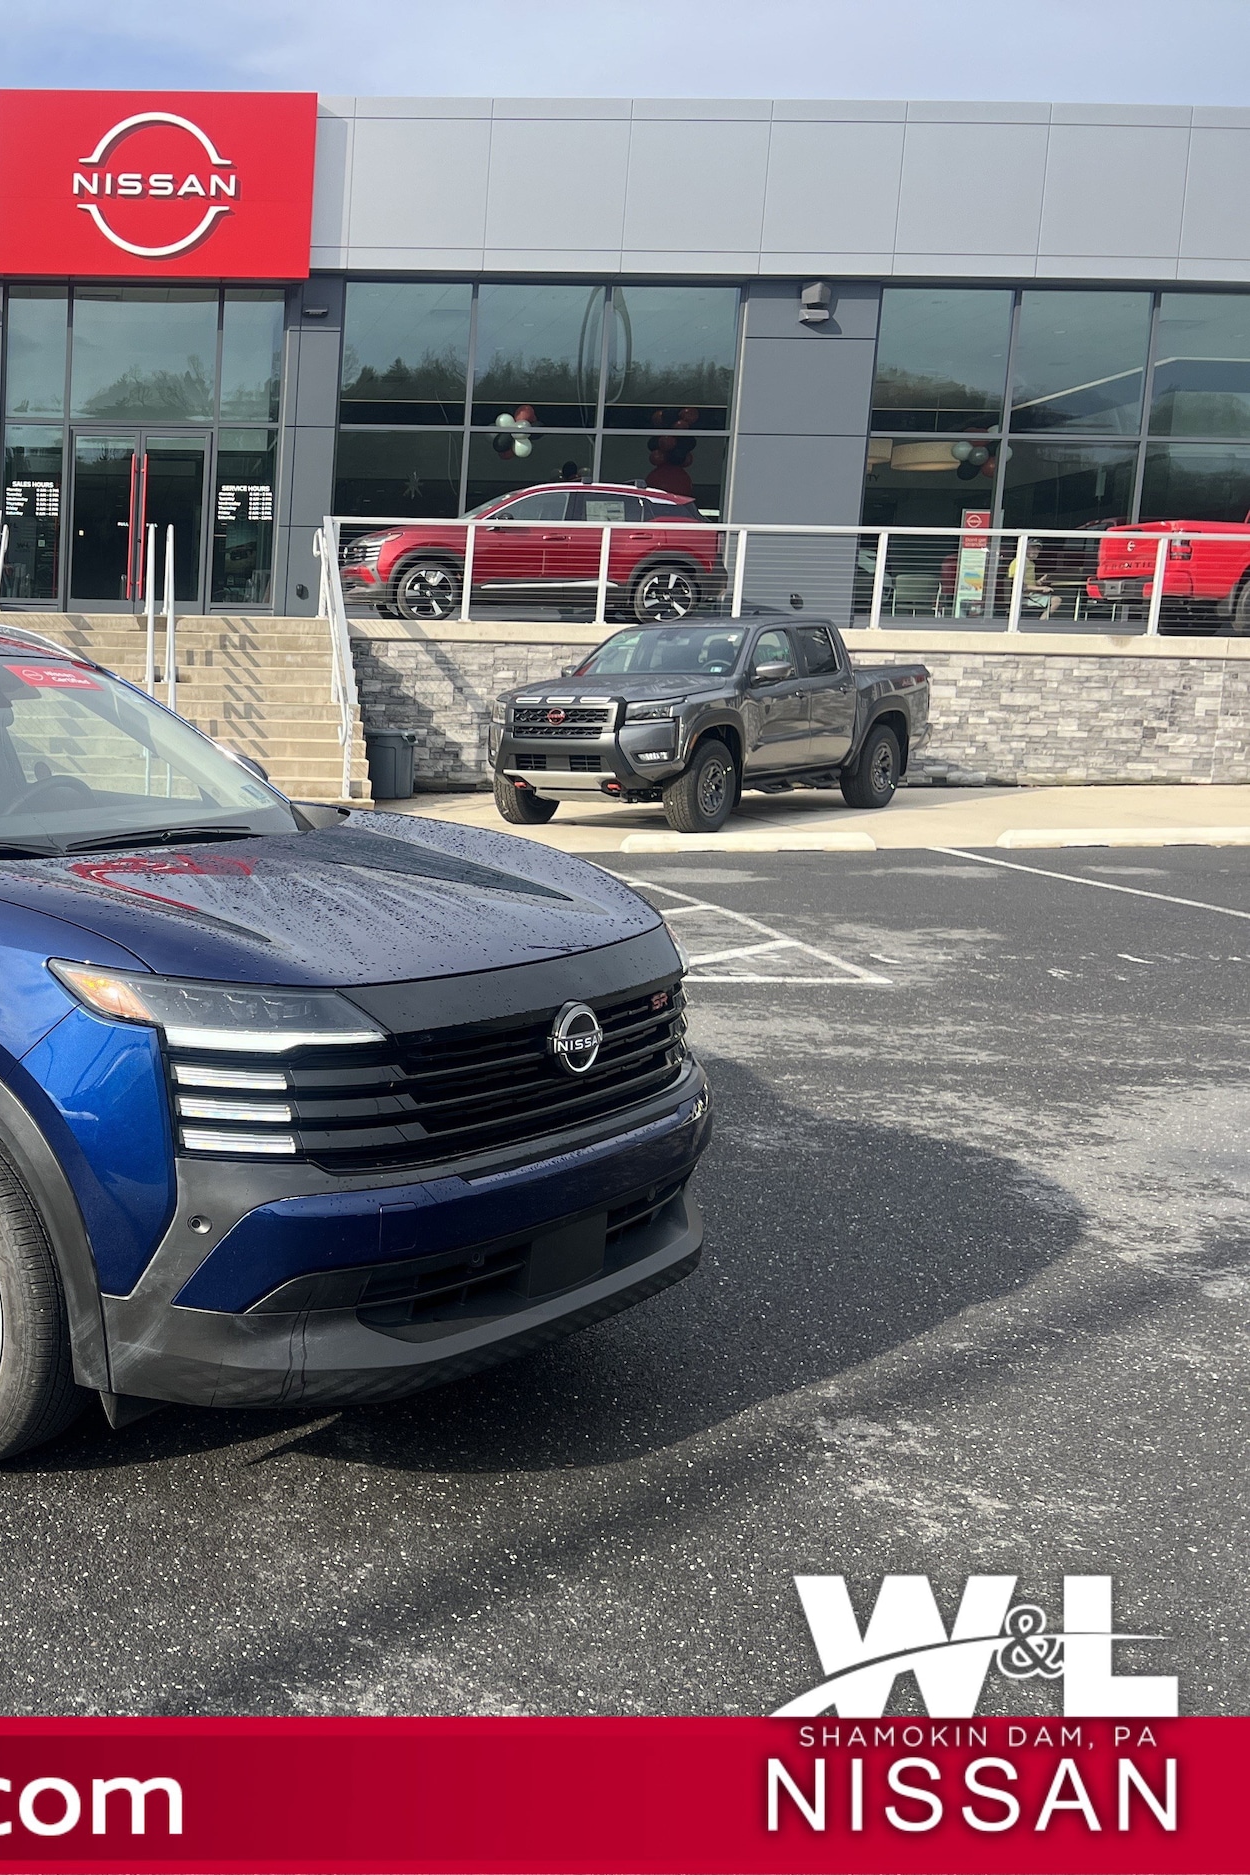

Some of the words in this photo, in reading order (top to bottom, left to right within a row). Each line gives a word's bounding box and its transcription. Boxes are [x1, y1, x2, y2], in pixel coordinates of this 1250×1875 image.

[72, 172, 236, 197] NISSAN
[1104, 561, 1155, 571] FRONTIE
[557, 1030, 603, 1052] NISSAN
